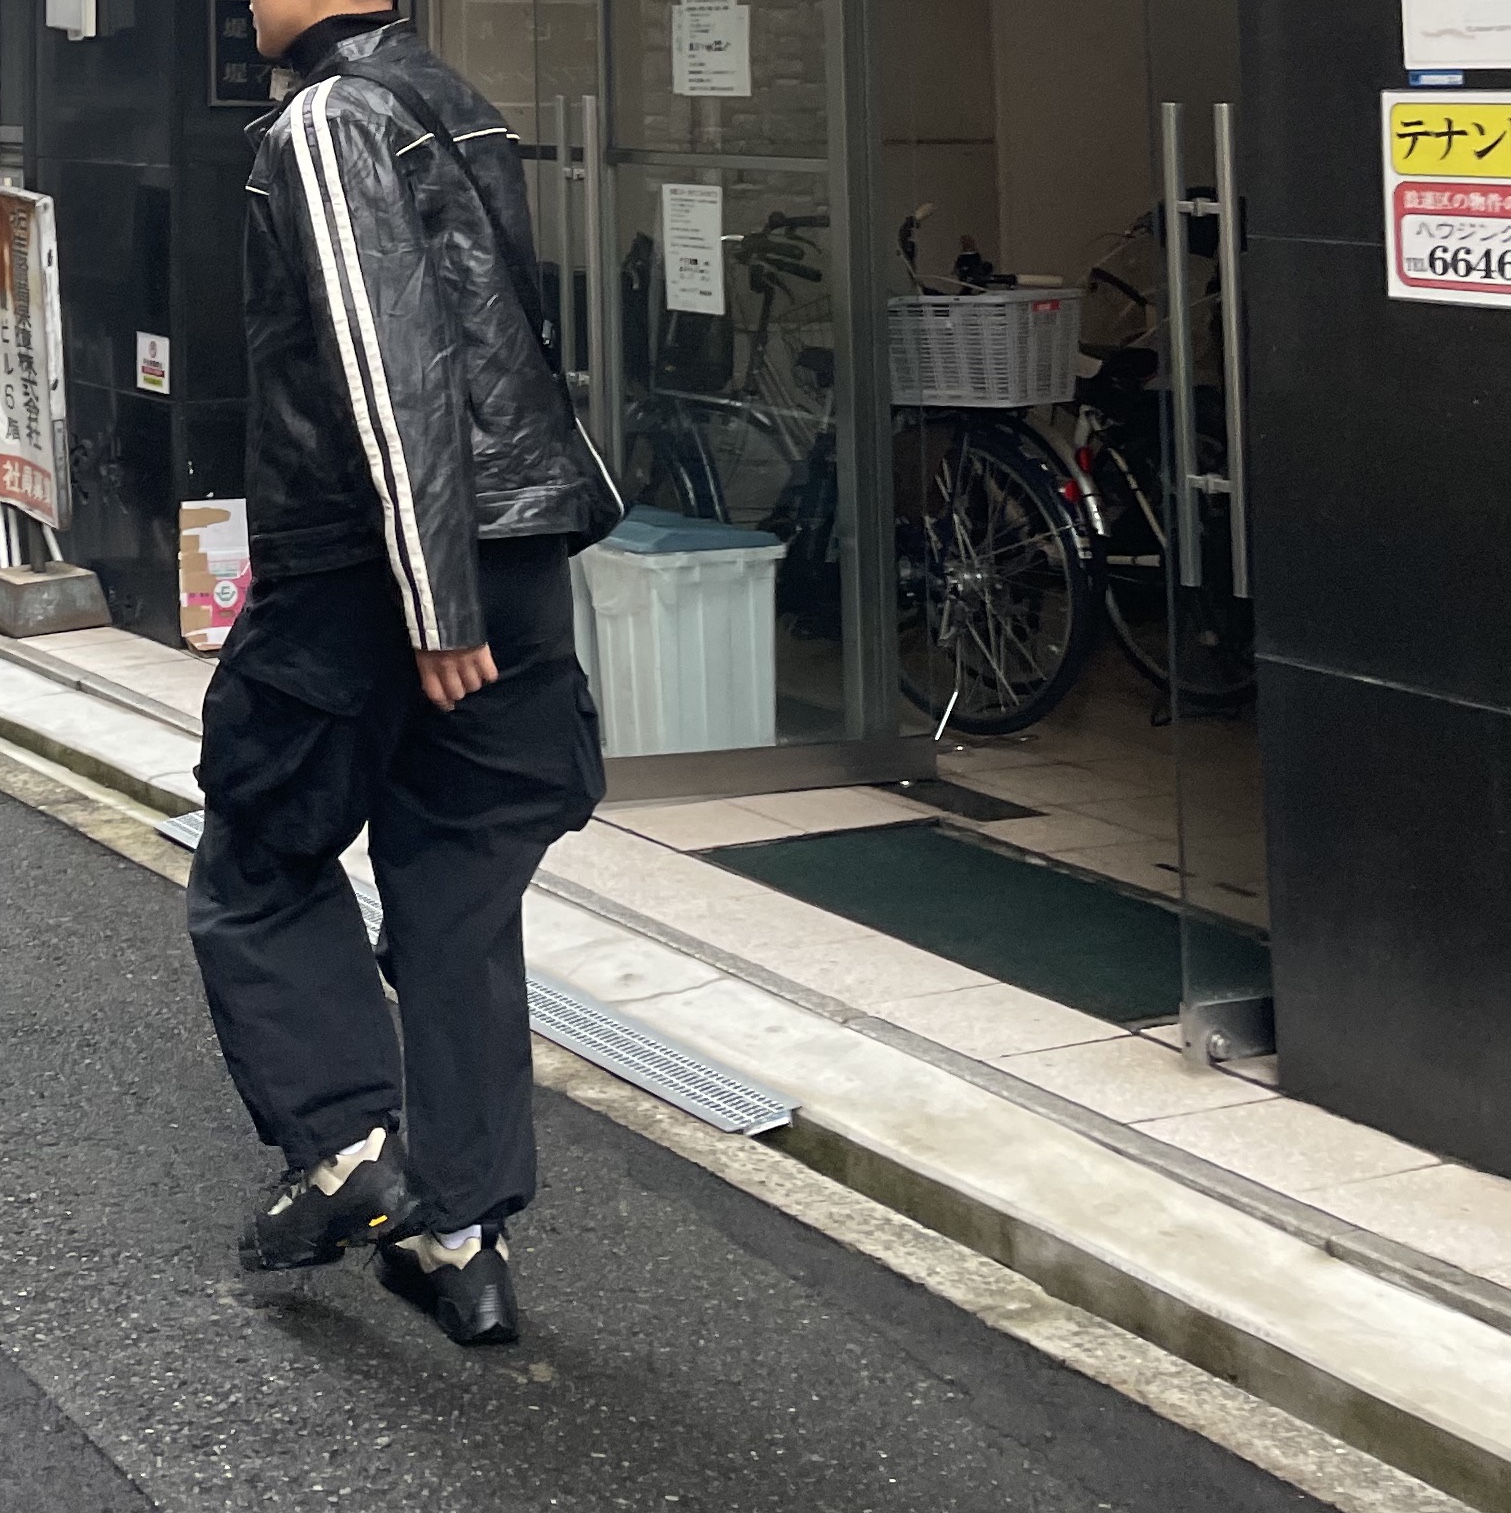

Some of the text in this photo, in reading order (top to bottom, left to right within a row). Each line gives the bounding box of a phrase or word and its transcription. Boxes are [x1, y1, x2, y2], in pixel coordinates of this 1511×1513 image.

[1396, 117, 1511, 160] テナン
[1406, 244, 1511, 281] TEL 6646
